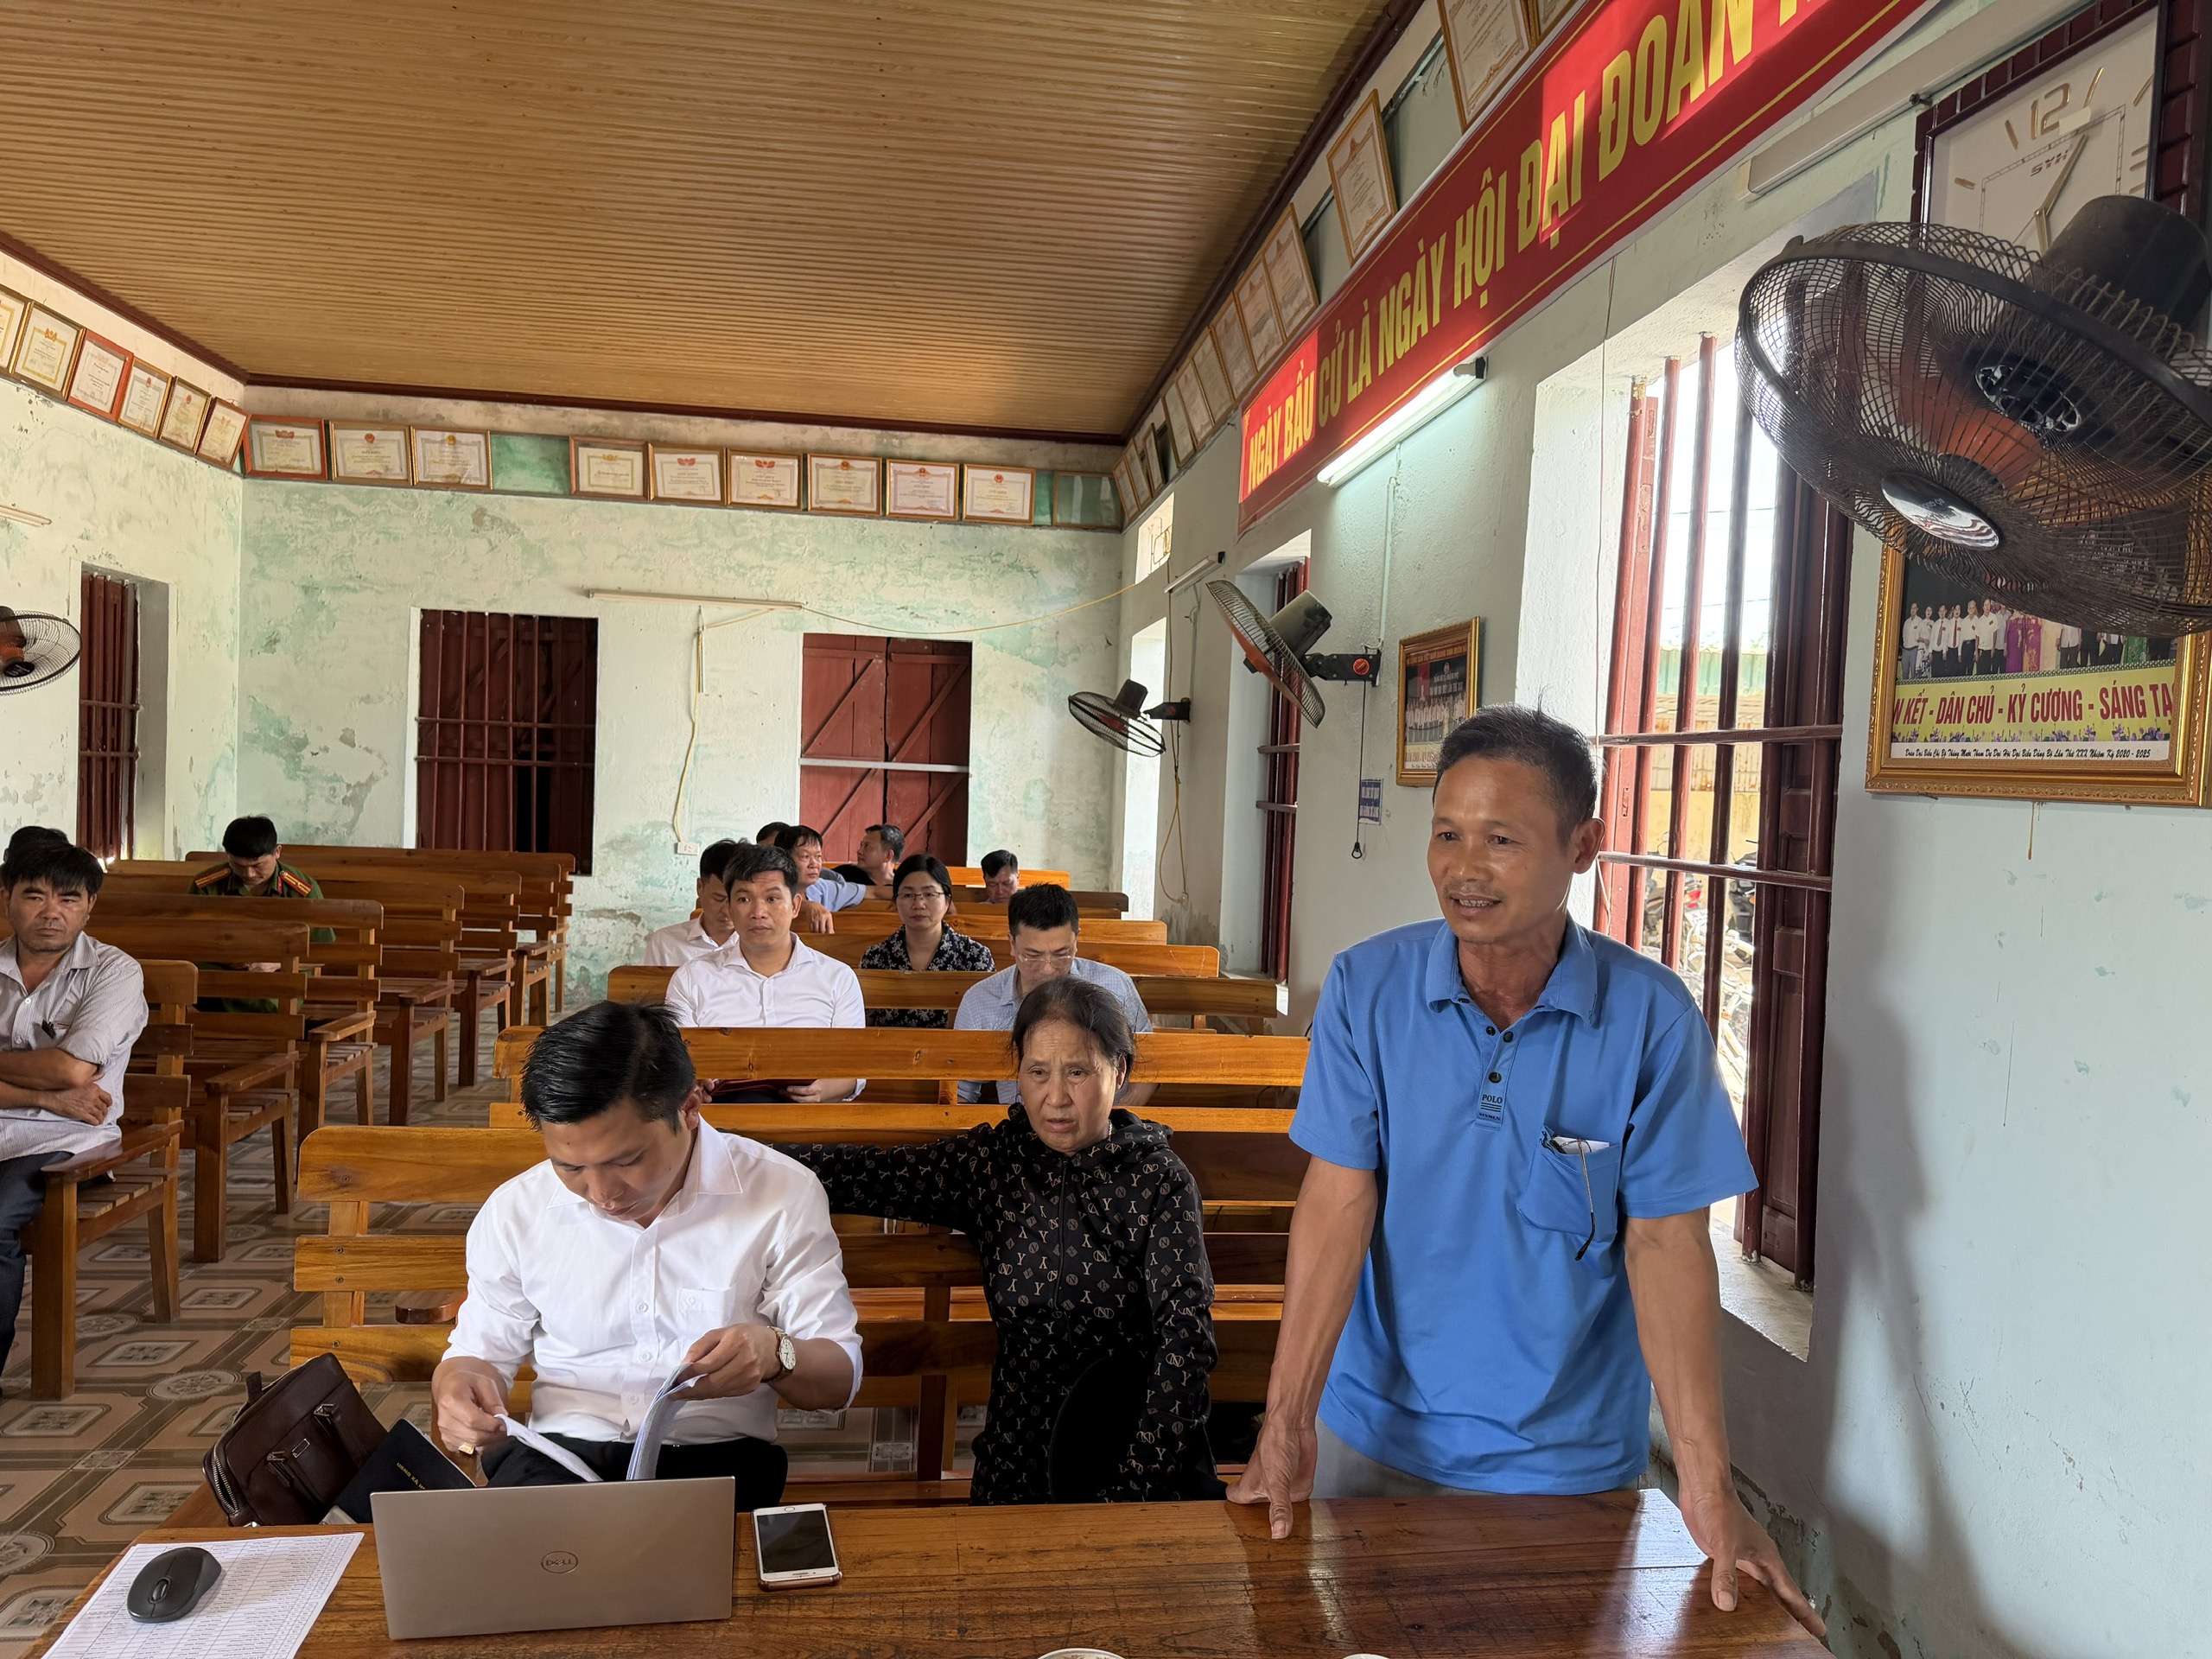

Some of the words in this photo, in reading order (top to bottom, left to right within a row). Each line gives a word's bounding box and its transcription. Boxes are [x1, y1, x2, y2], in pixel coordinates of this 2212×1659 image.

[2031, 82, 2070, 140] 12
[1247, 404, 1282, 495] NGÀY
[1283, 359, 1315, 461] BẦU
[1319, 319, 1345, 428] CỬ
[1347, 298, 1372, 404] LÀ
[1377, 232, 1447, 377] NGÀY
[1453, 166, 1508, 309] HỘI
[1517, 89, 1586, 253] ĐẠI
[1903, 689, 1929, 725] KẾT
[1936, 691, 1966, 725] DÂN
[1966, 684, 1995, 725] CHỦ
[2006, 683, 2027, 724] KỶ
[2031, 687, 2082, 723] CƯƠNG
[2099, 679, 2147, 721] SÁNG
[2115, 748, 2131, 758] 2020
[2135, 748, 2152, 758] 2025
[1482, 1094, 1503, 1104] POLO
[546, 1558, 575, 1567] DELL
